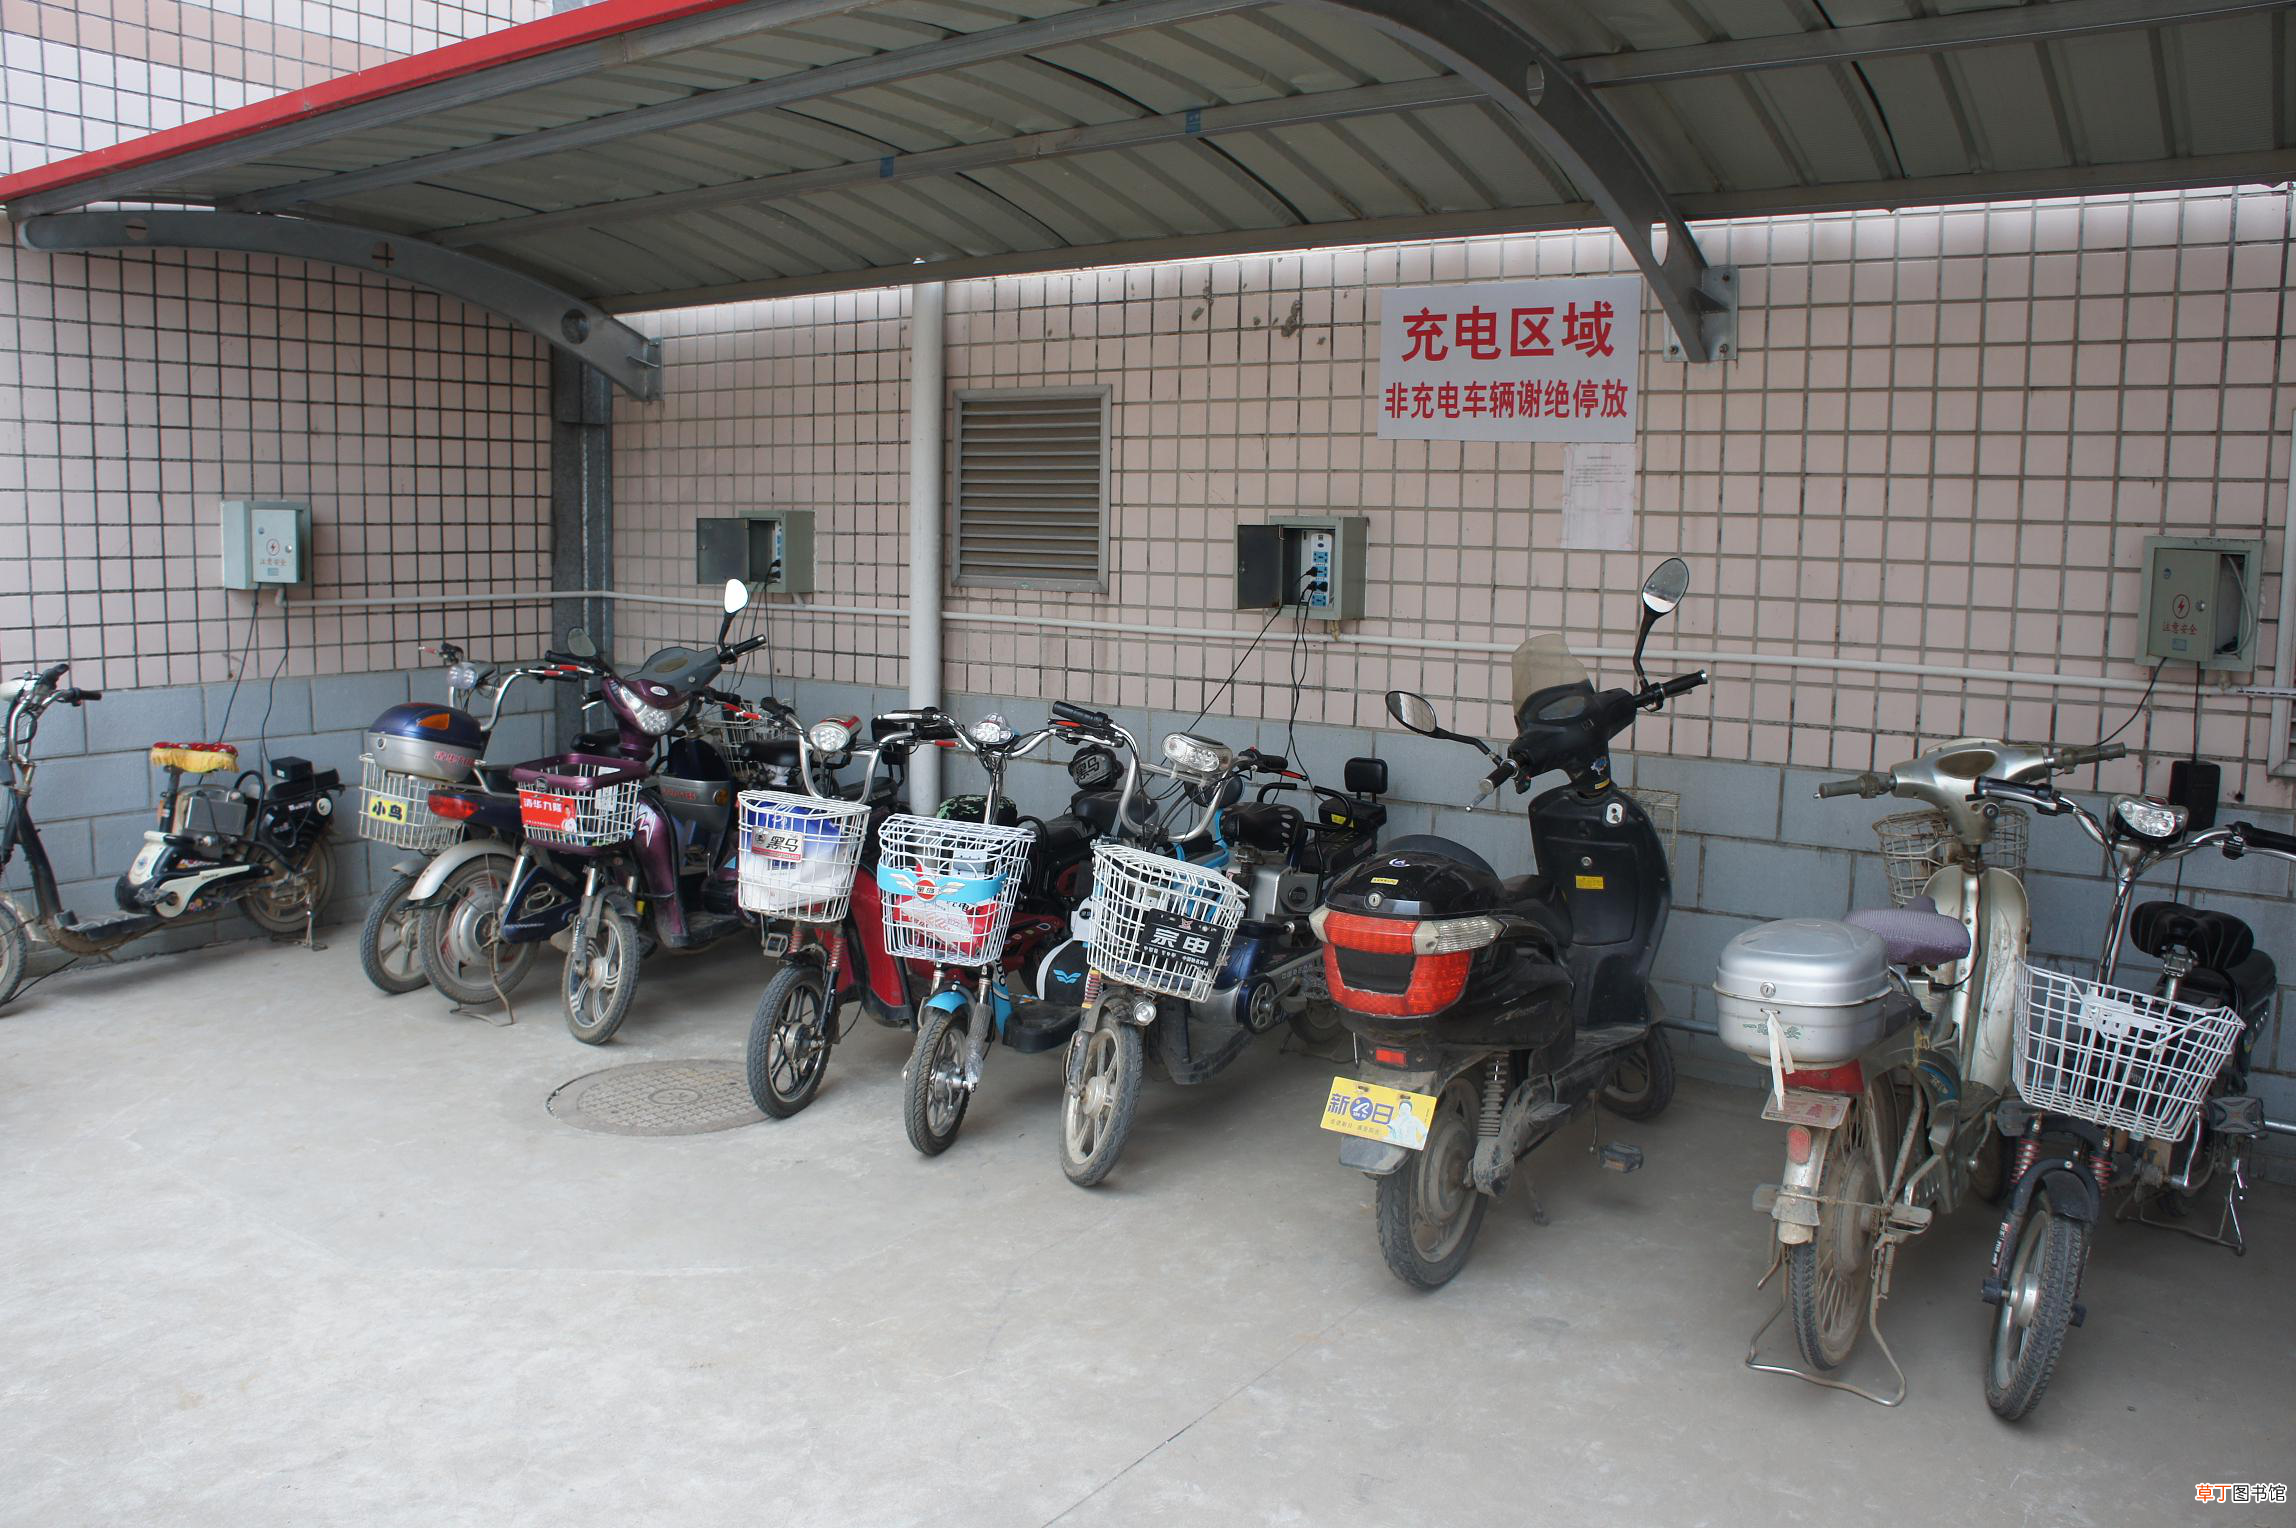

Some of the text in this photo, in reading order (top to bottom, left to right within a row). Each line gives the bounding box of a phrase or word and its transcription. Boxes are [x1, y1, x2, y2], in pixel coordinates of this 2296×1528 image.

[1401, 300, 1615, 362] 充电区域
[1384, 378, 1629, 419] 非充电车辆谢绝停放
[2162, 621, 2198, 635] 注意安全
[765, 834, 799, 852] 黑马
[1150, 927, 1211, 954] 宗申
